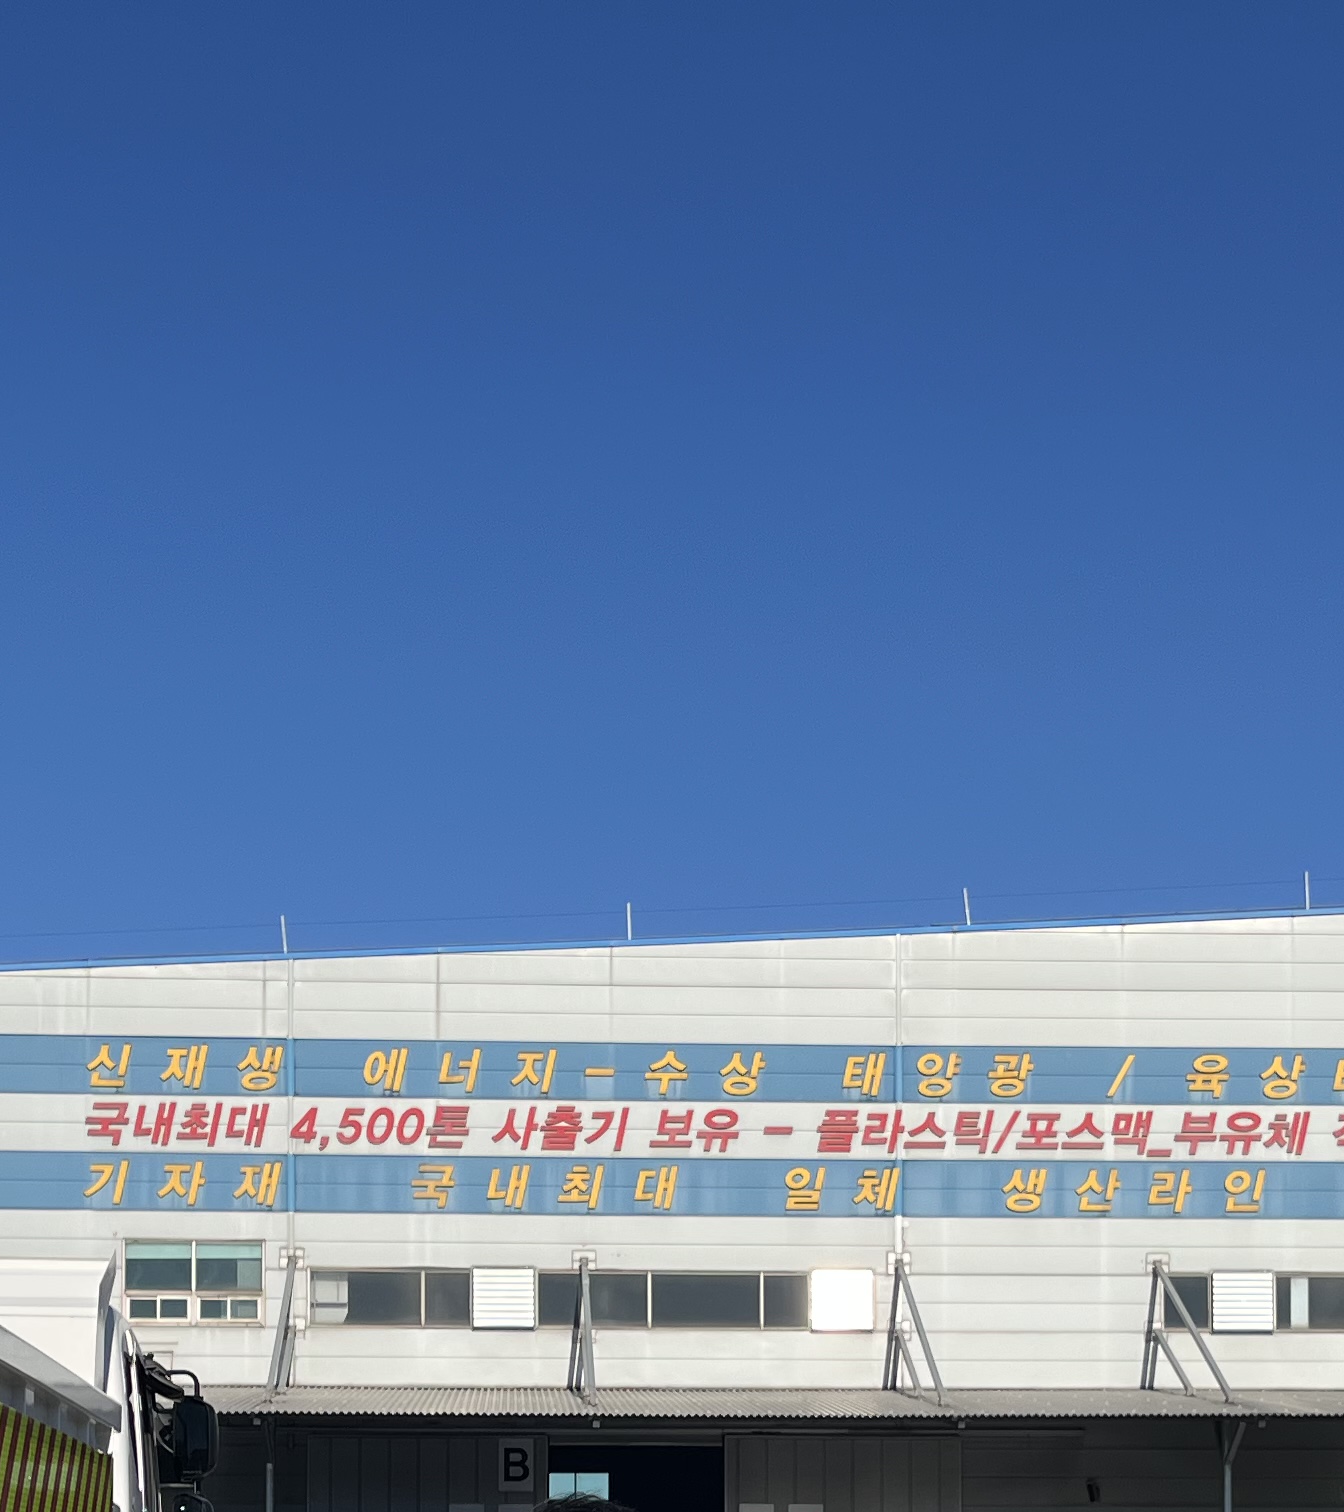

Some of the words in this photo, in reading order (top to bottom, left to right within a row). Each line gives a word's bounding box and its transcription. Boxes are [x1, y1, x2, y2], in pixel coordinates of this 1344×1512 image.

[86, 1043, 284, 1092] 신재생
[842, 1052, 1034, 1099] 태양광
[85, 1102, 270, 1148] 국내최대
[290, 1105, 470, 1152] 4,500톤
[491, 1105, 631, 1153] 사출기
[649, 1108, 740, 1153] 보유
[83, 1160, 284, 1208] 기자재
[411, 1163, 680, 1211] 국내최대
[784, 1166, 900, 1212] 일체
[1002, 1168, 1266, 1214] 생산라인
[503, 1447, 530, 1482] B
